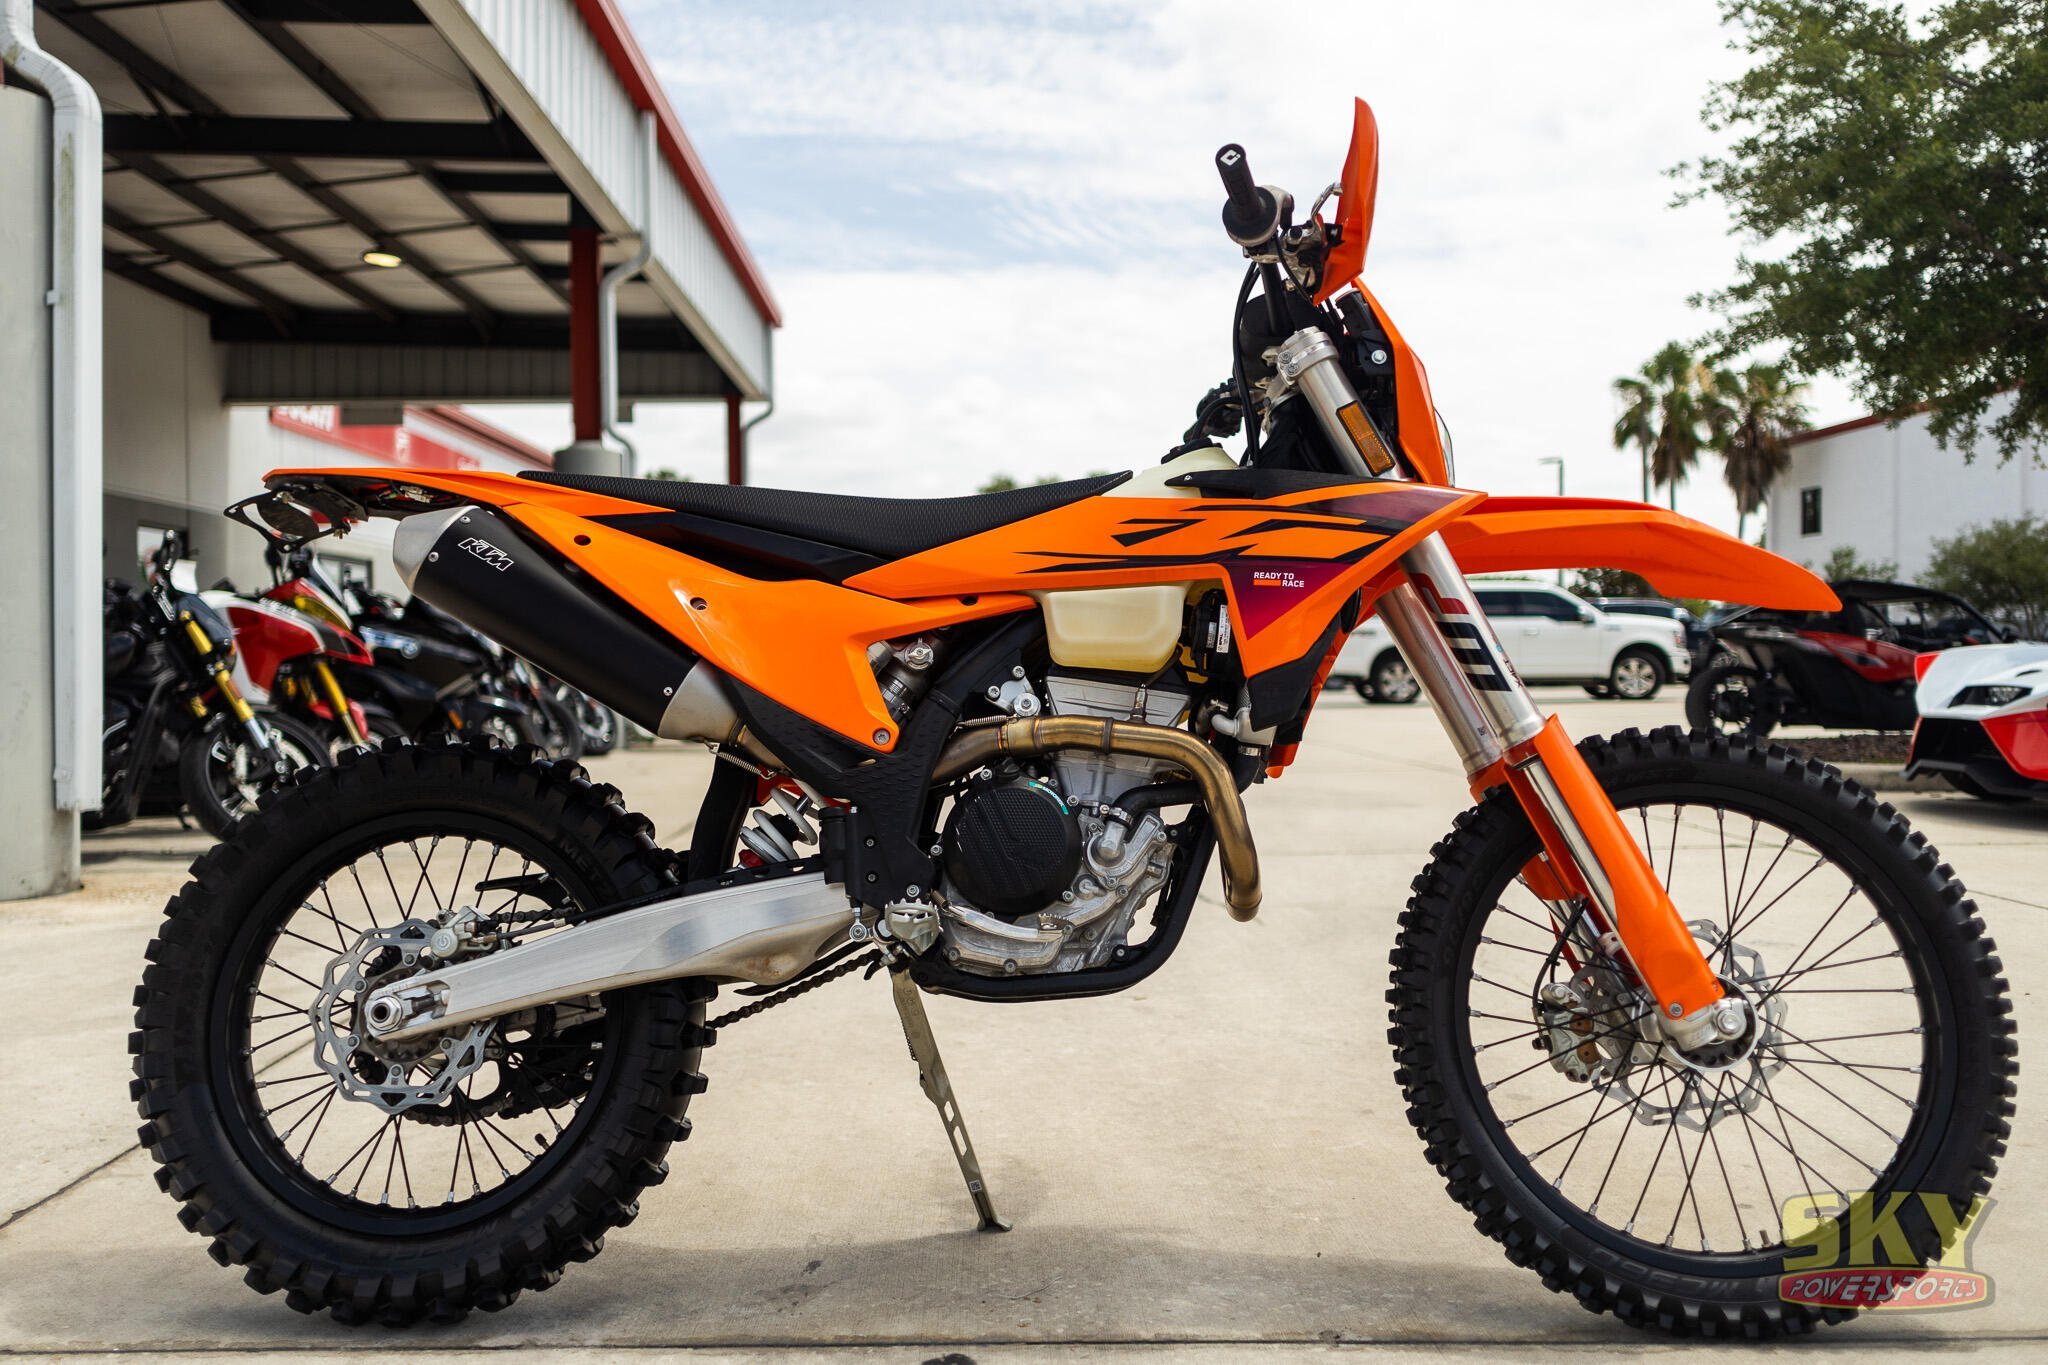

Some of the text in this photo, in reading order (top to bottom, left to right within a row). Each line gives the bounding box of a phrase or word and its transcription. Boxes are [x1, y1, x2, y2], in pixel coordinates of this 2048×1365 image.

[457, 537, 514, 572] KTM
[1253, 571, 1295, 580] READY TO
[1282, 580, 1305, 588] RACE
